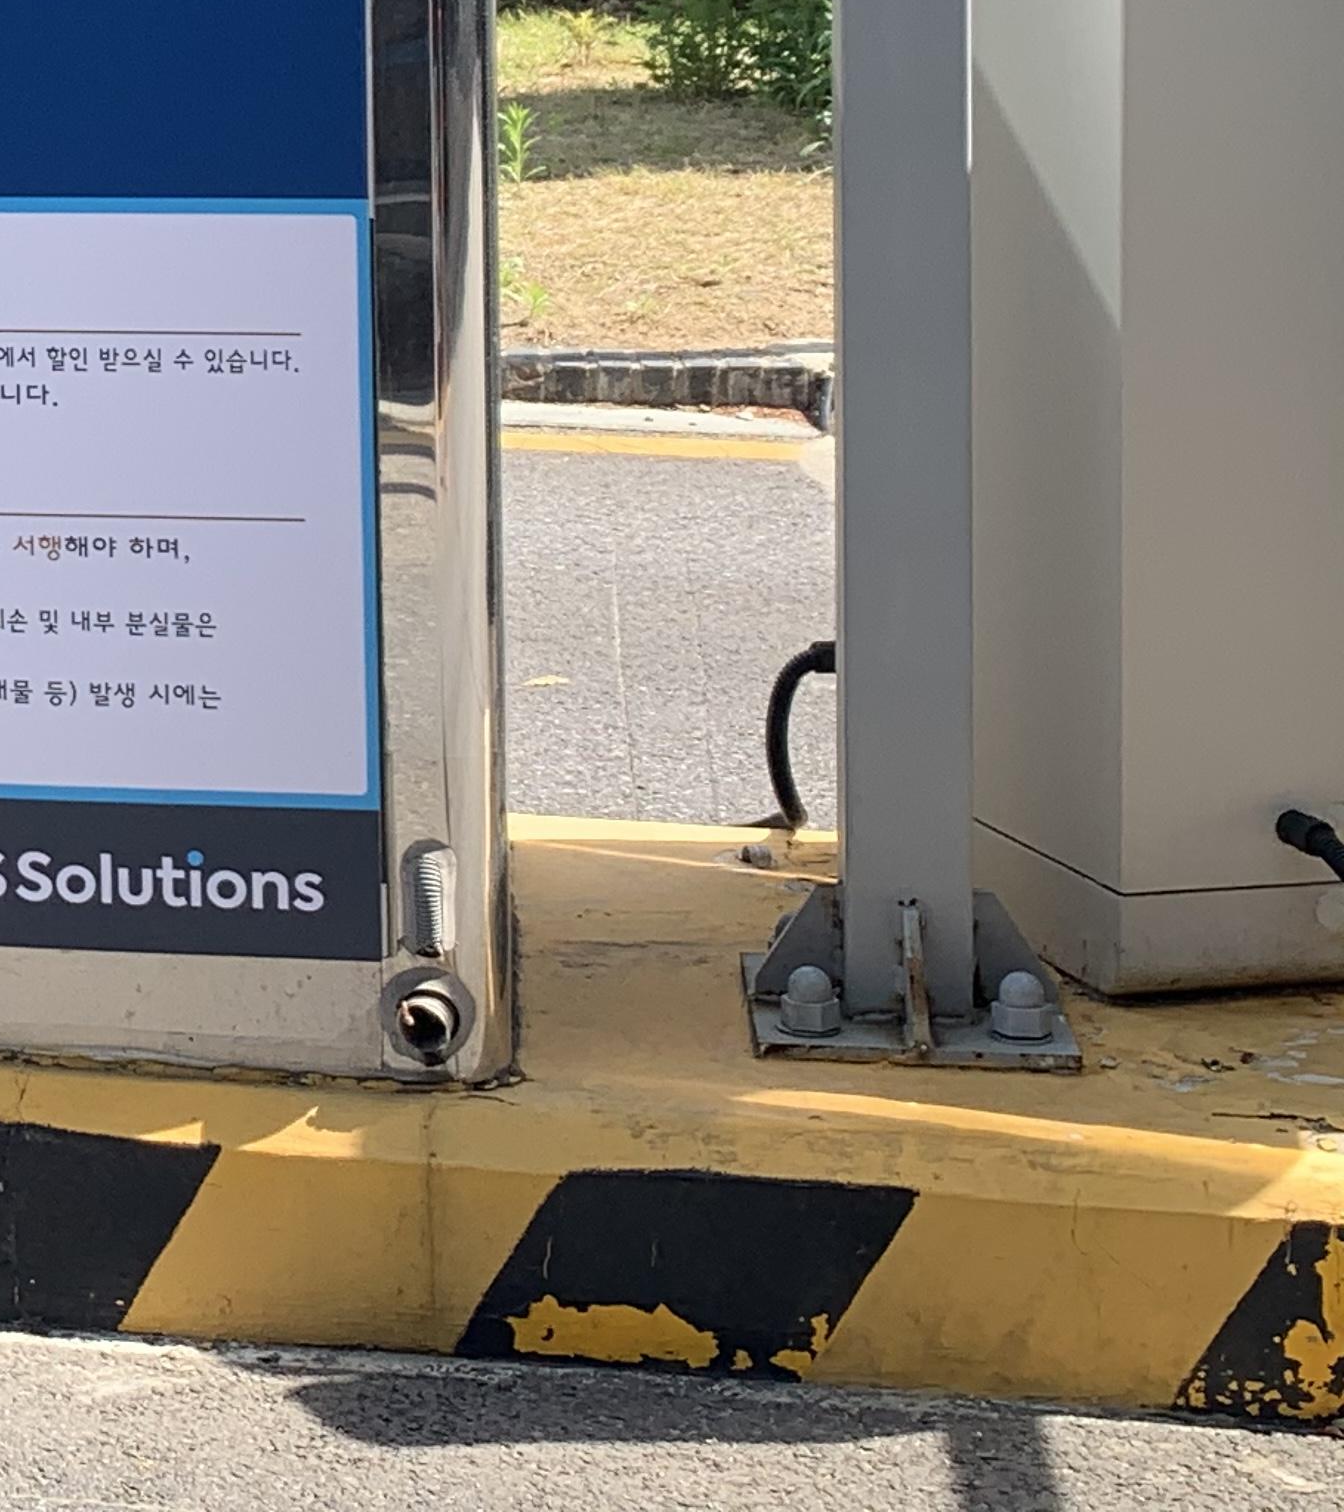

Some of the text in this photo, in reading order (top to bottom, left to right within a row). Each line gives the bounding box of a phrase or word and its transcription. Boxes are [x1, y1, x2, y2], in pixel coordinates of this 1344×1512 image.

[46, 347, 87, 371] 할인
[100, 348, 161, 372] 받으실
[174, 349, 194, 370] 수
[205, 349, 298, 373] 있습니다.
[13, 536, 116, 560] 서행해야
[129, 537, 189, 563] 하며,
[40, 610, 58, 634] 및
[72, 611, 114, 632] 내부
[126, 612, 216, 638] 분실물은
[44, 681, 76, 706] 등)
[90, 682, 134, 708] 발생
[149, 684, 221, 709] 시에는
